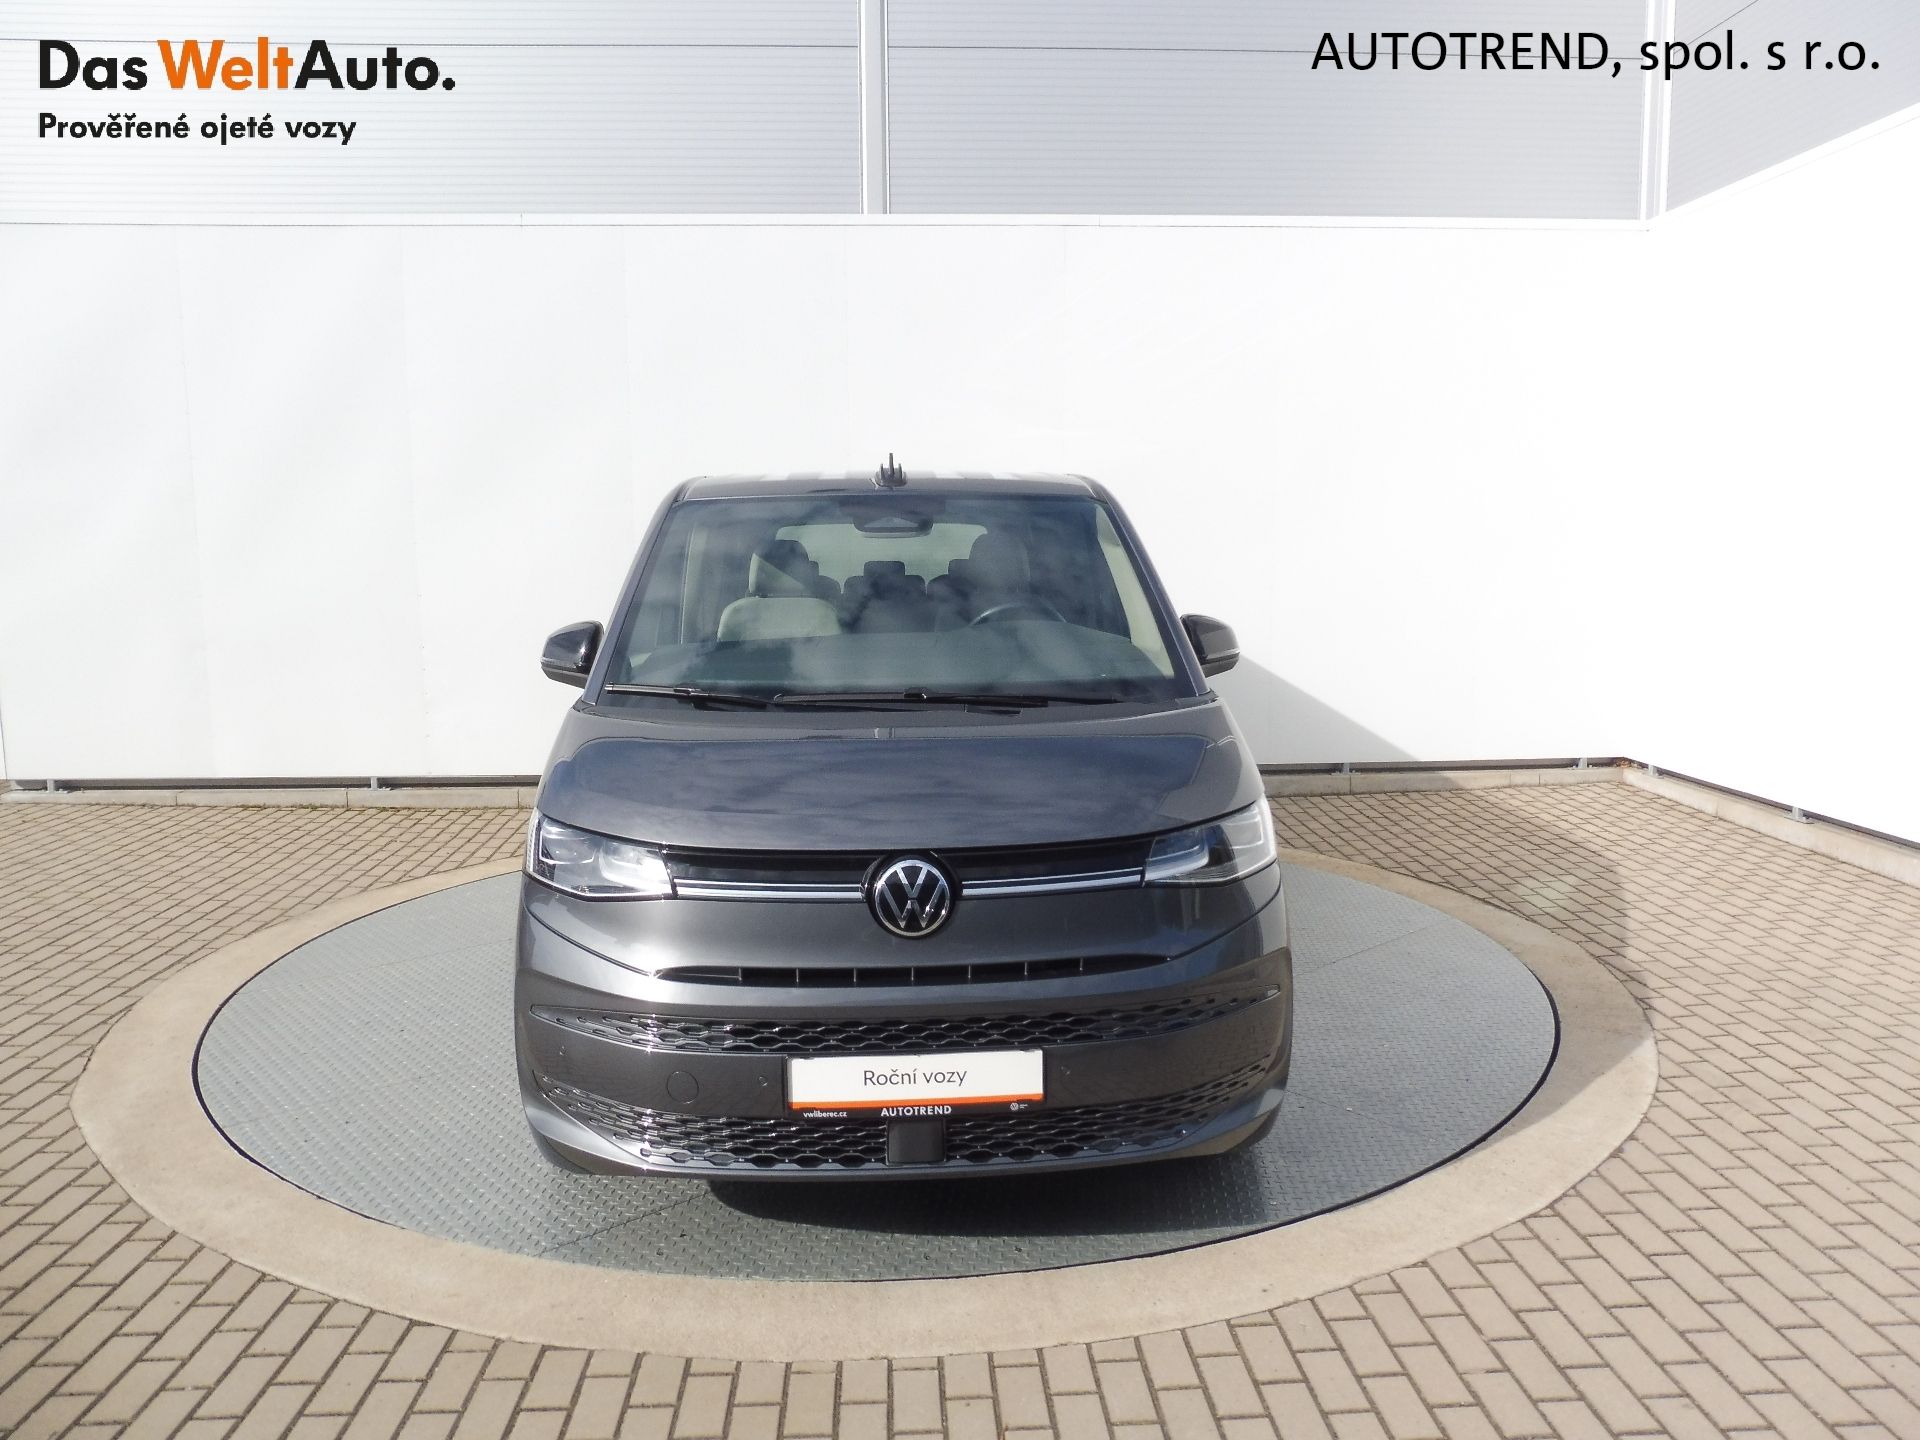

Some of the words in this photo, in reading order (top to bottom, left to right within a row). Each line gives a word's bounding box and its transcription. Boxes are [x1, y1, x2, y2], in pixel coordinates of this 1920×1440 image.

[863, 1068, 917, 1087] Roční
[922, 1069, 967, 1087] vozy
[802, 1110, 848, 1118] vwliberec.cz
[880, 1105, 952, 1117] AUTOTREND
